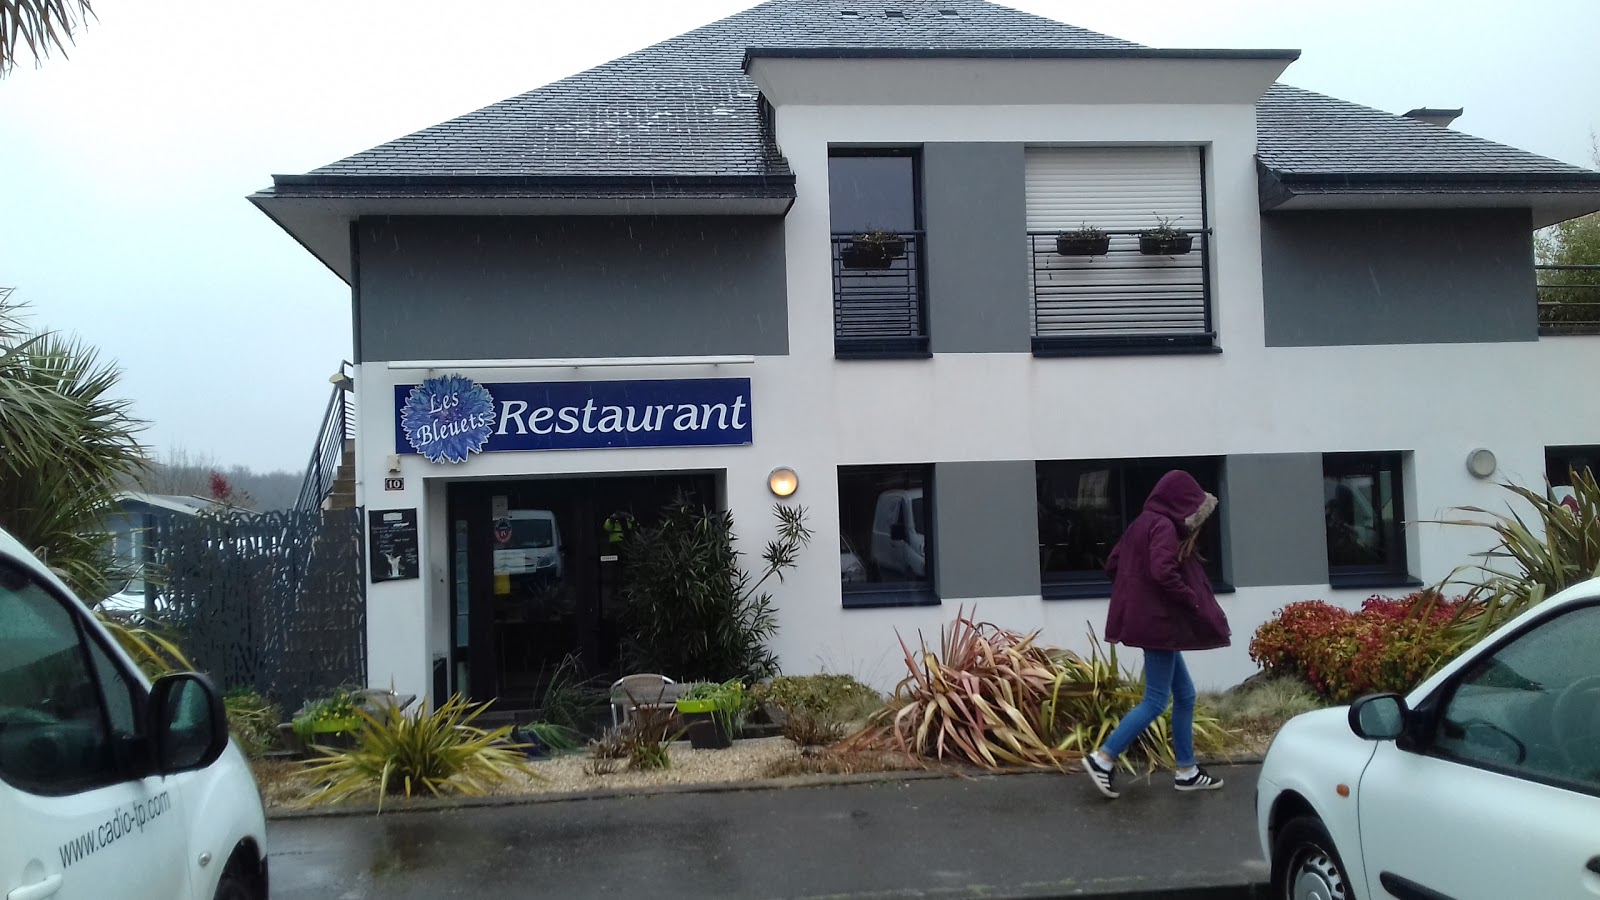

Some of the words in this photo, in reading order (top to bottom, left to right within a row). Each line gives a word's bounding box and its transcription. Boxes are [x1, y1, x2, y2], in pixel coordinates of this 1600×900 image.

[429, 391, 460, 414] Les
[496, 396, 747, 435] Restaurant
[416, 412, 486, 447] Bleuets
[388, 479, 401, 489] 10
[59, 790, 171, 868] www.cadio-tp.com
